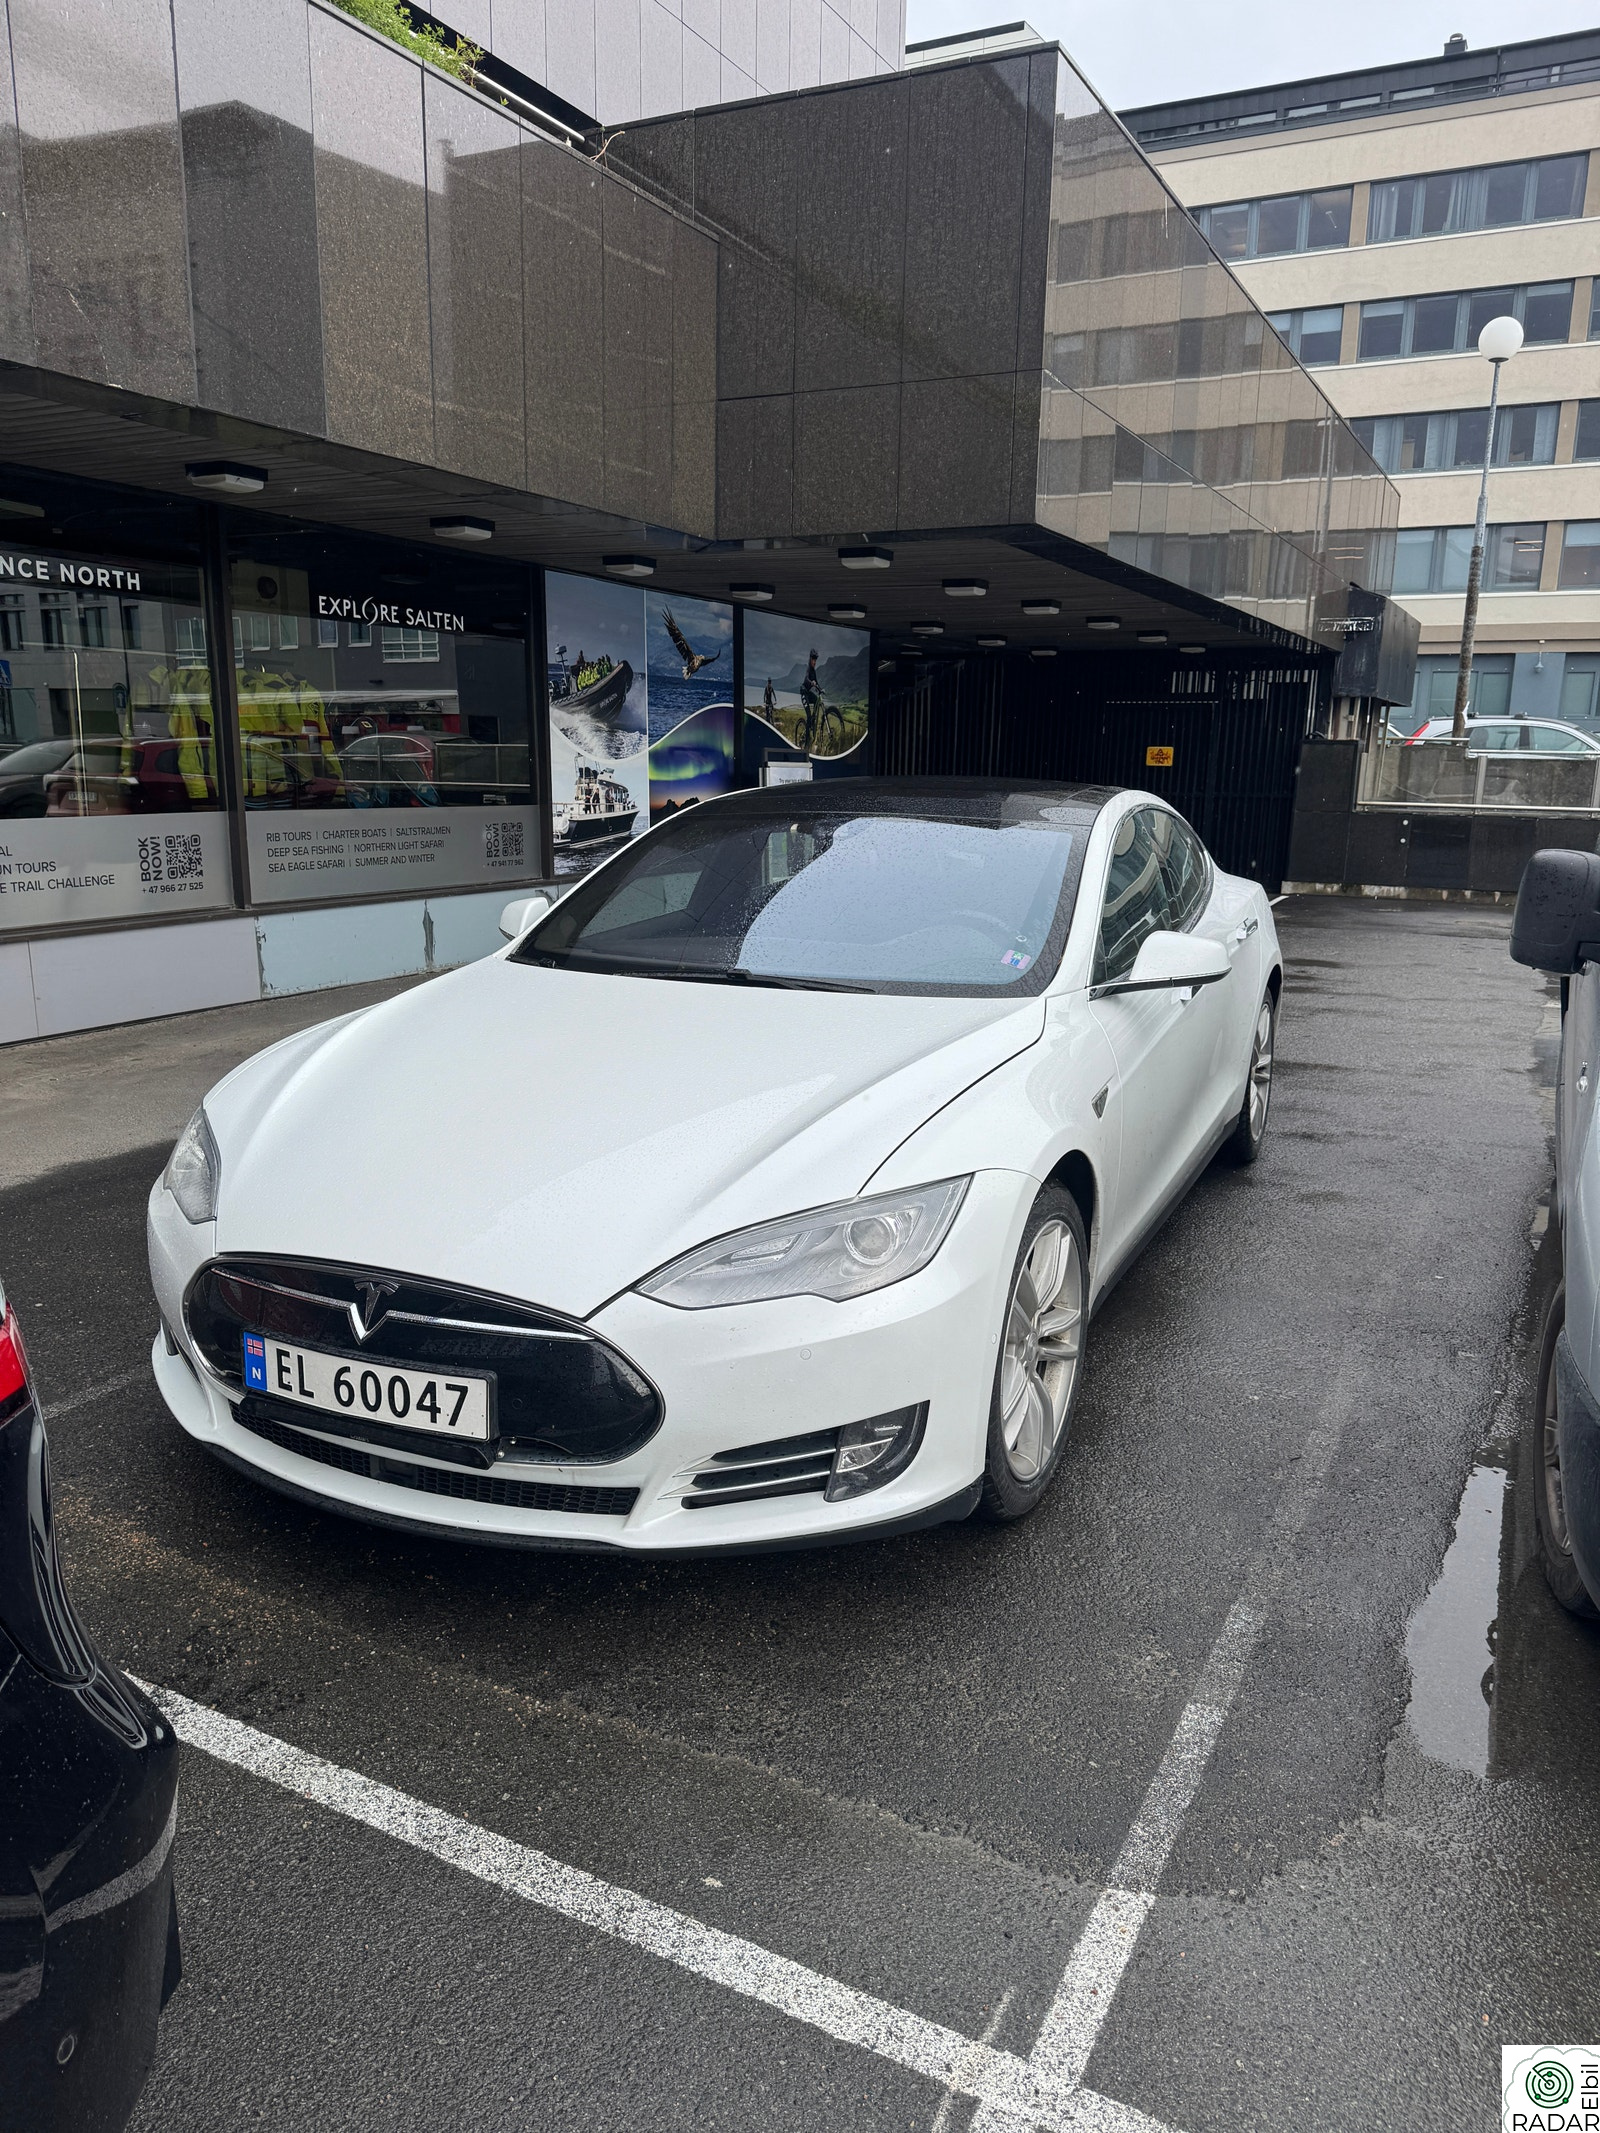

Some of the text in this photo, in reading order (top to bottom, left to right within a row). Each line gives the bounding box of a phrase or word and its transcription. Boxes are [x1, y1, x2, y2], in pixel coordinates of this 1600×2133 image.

[0, 555, 141, 591] NCE NORTH
[318, 595, 464, 632] EXPLORE SALTEN
[266, 826, 451, 842] RIB TOURS CHARTER BOATS SALTSTRAUMEN
[267, 839, 445, 858] DEEP SEA FISHING NORTHERN LIGHT SAFARI
[485, 823, 493, 858] BOOK
[492, 823, 500, 857] NOW!
[15, 860, 57, 874] TOURS
[138, 837, 151, 882] BOOK
[150, 836, 163, 881] NOW!
[268, 853, 435, 873] SEA EAGLE SAFARI SUMMER AND WINTER
[10, 880, 45, 893] TRAIL
[47, 874, 115, 890] CHALLENGE
[160, 884, 176, 893] 966
[178, 882, 187, 892] 27
[189, 882, 204, 891] 525
[251, 1346, 470, 1427] N EL 60047
